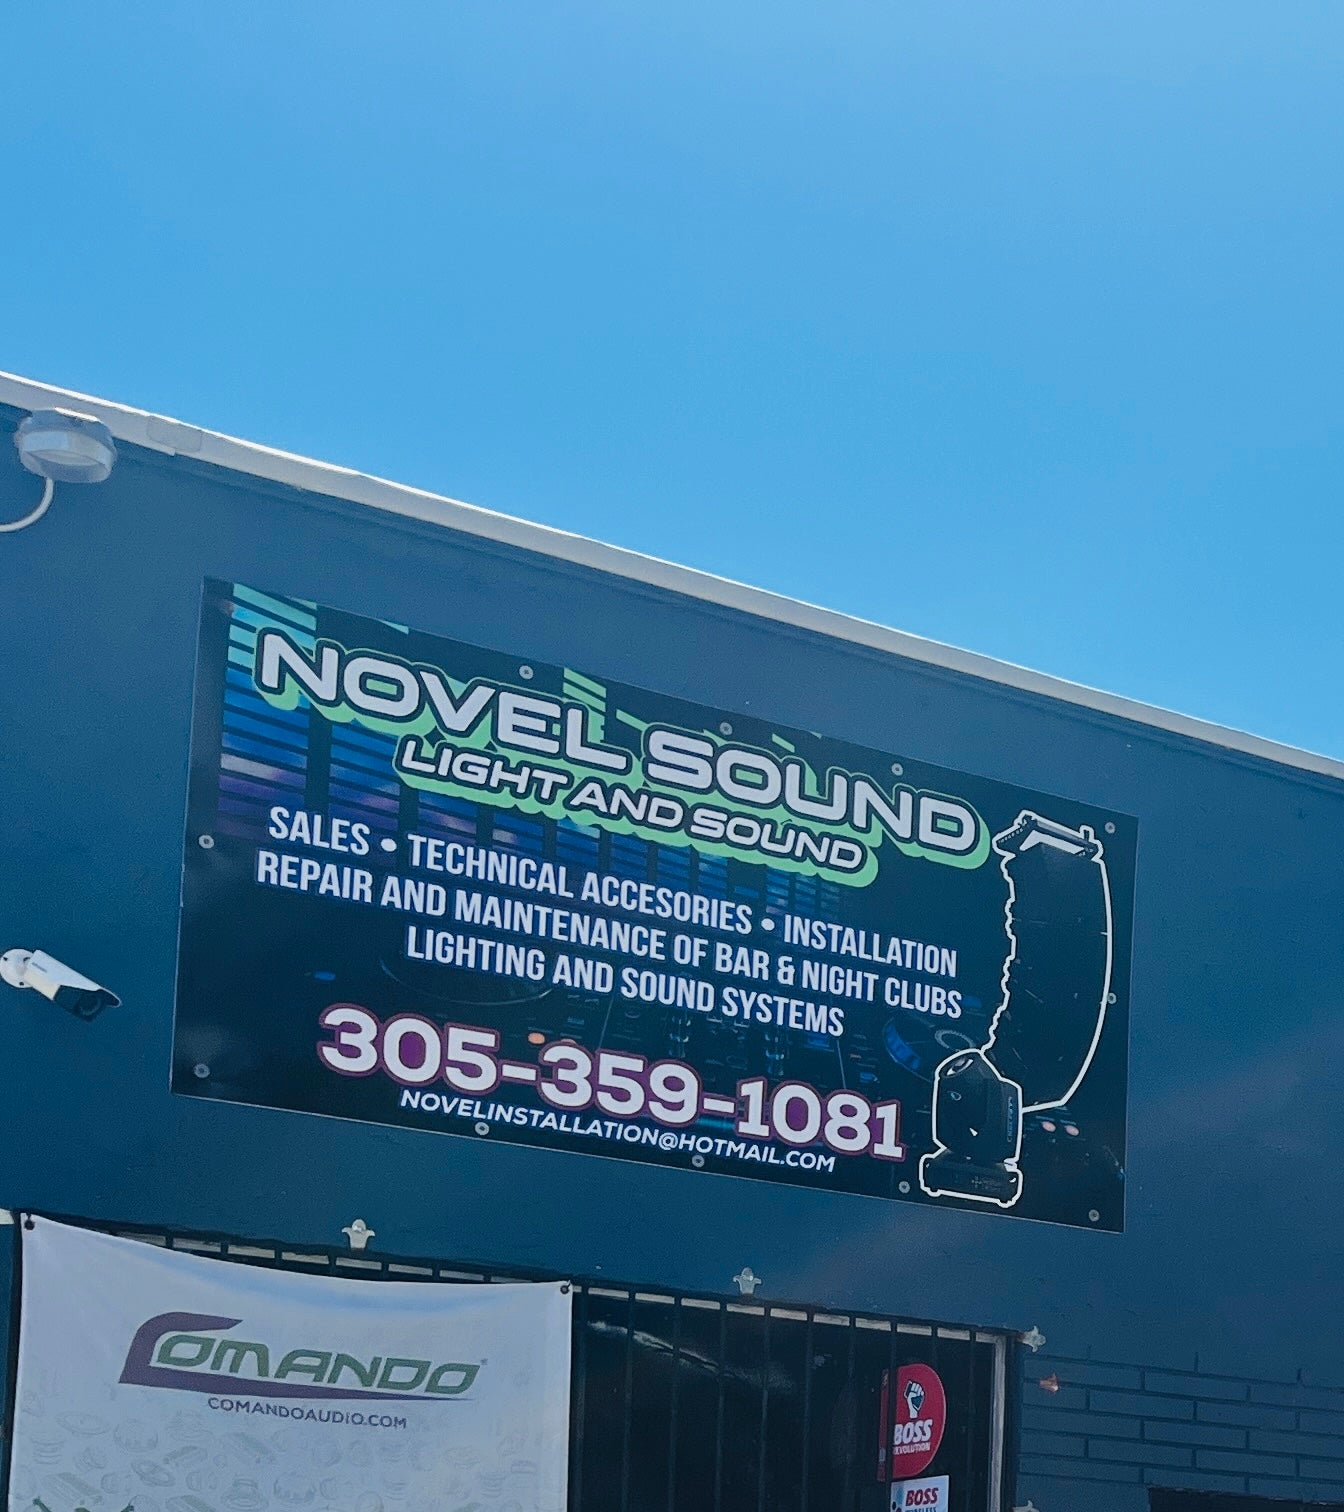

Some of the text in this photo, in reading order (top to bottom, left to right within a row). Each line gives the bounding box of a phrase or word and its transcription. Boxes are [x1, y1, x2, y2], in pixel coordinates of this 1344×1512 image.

[258, 631, 978, 852] NOVEL SOUND
[400, 739, 863, 870] LIGHT AND SOUND
[256, 850, 963, 1020] REPAIR AND MAINTENANCE OF BAR & NIGHT CLUBS
[268, 805, 958, 979] SALES TECHNICAL ACCESORIES INSTALLATION
[407, 924, 845, 1038] LIGHTING AND SOUND SYSTEMS
[320, 1004, 906, 1160] 305-359-1081
[399, 1089, 836, 1175] NOVELINSTALLATION@HOTMAIL.COM
[118, 1311, 484, 1401] COMANDO
[207, 1396, 408, 1430] COMANDOAUDIO.COM
[893, 1419, 933, 1446] BOSS
[905, 1487, 939, 1507] BOSS
